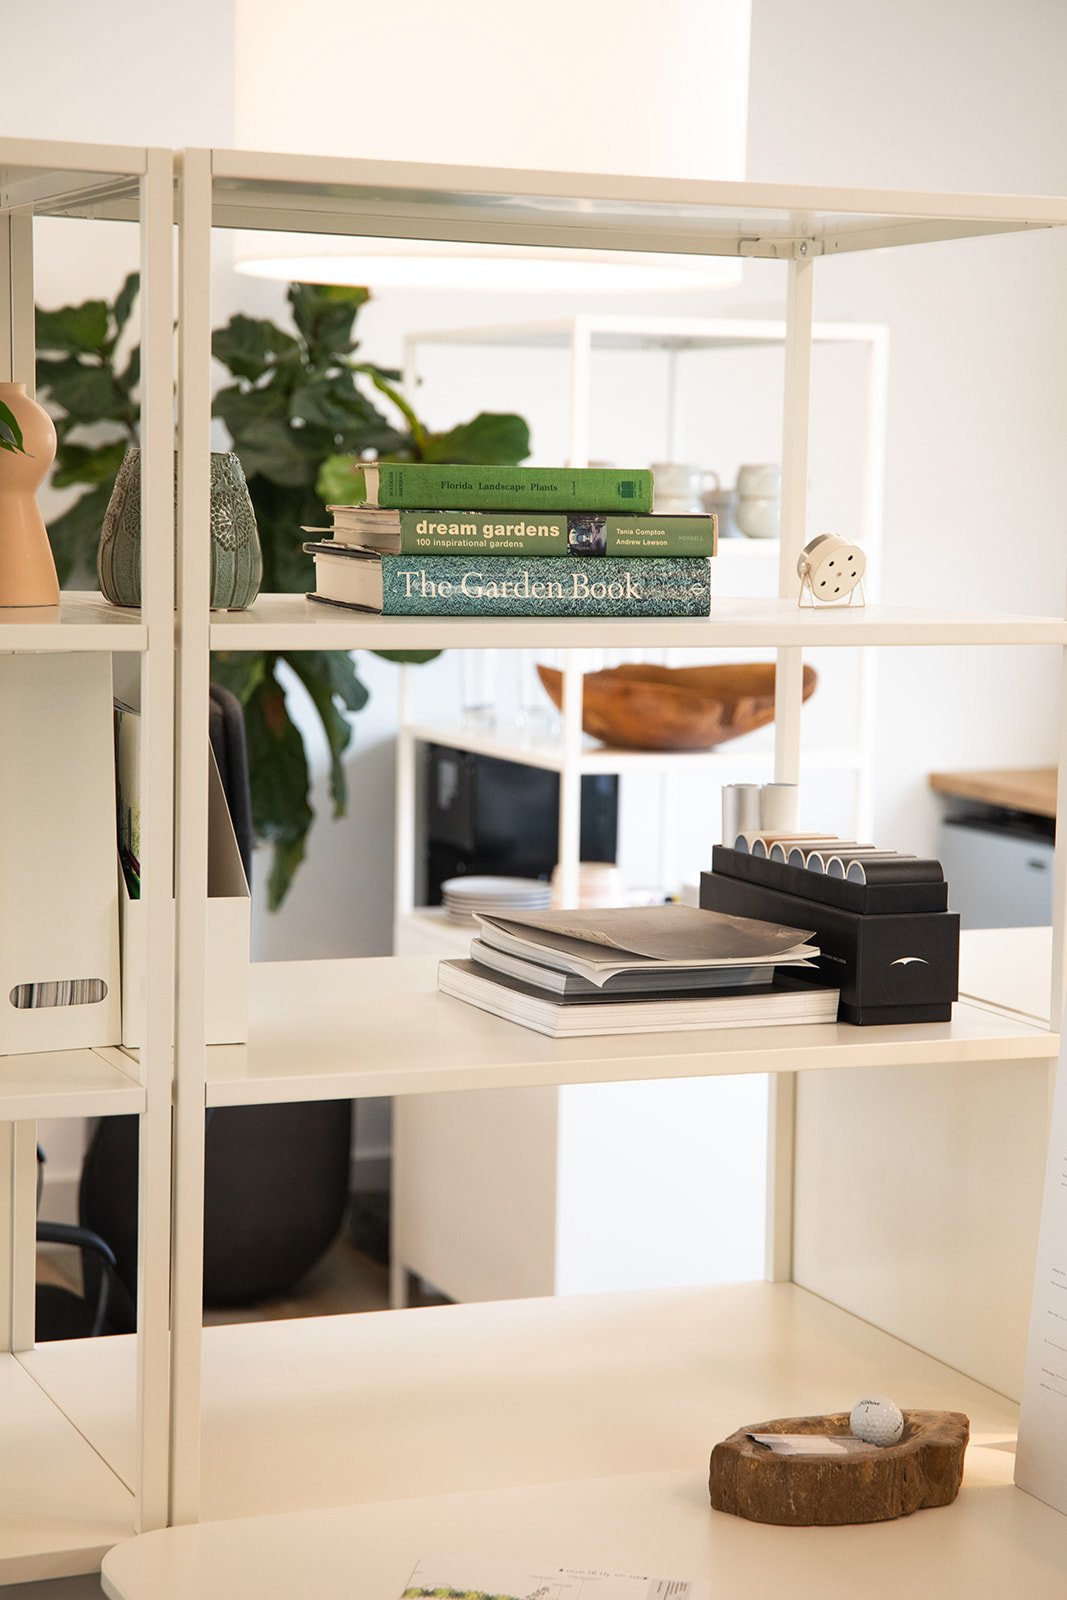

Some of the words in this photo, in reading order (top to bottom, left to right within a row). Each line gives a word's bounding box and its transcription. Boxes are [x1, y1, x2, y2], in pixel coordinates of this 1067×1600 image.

[441, 481, 473, 490] Florida
[479, 482, 525, 492] Landscape
[531, 483, 558, 491] Plants
[416, 520, 477, 535] dream
[482, 522, 560, 539] gardens
[416, 538, 431, 546] 100
[433, 539, 487, 547] inspirational
[489, 540, 524, 549] gardens
[397, 570, 452, 598] The
[461, 571, 563, 599] Garden
[571, 572, 642, 599] Book
